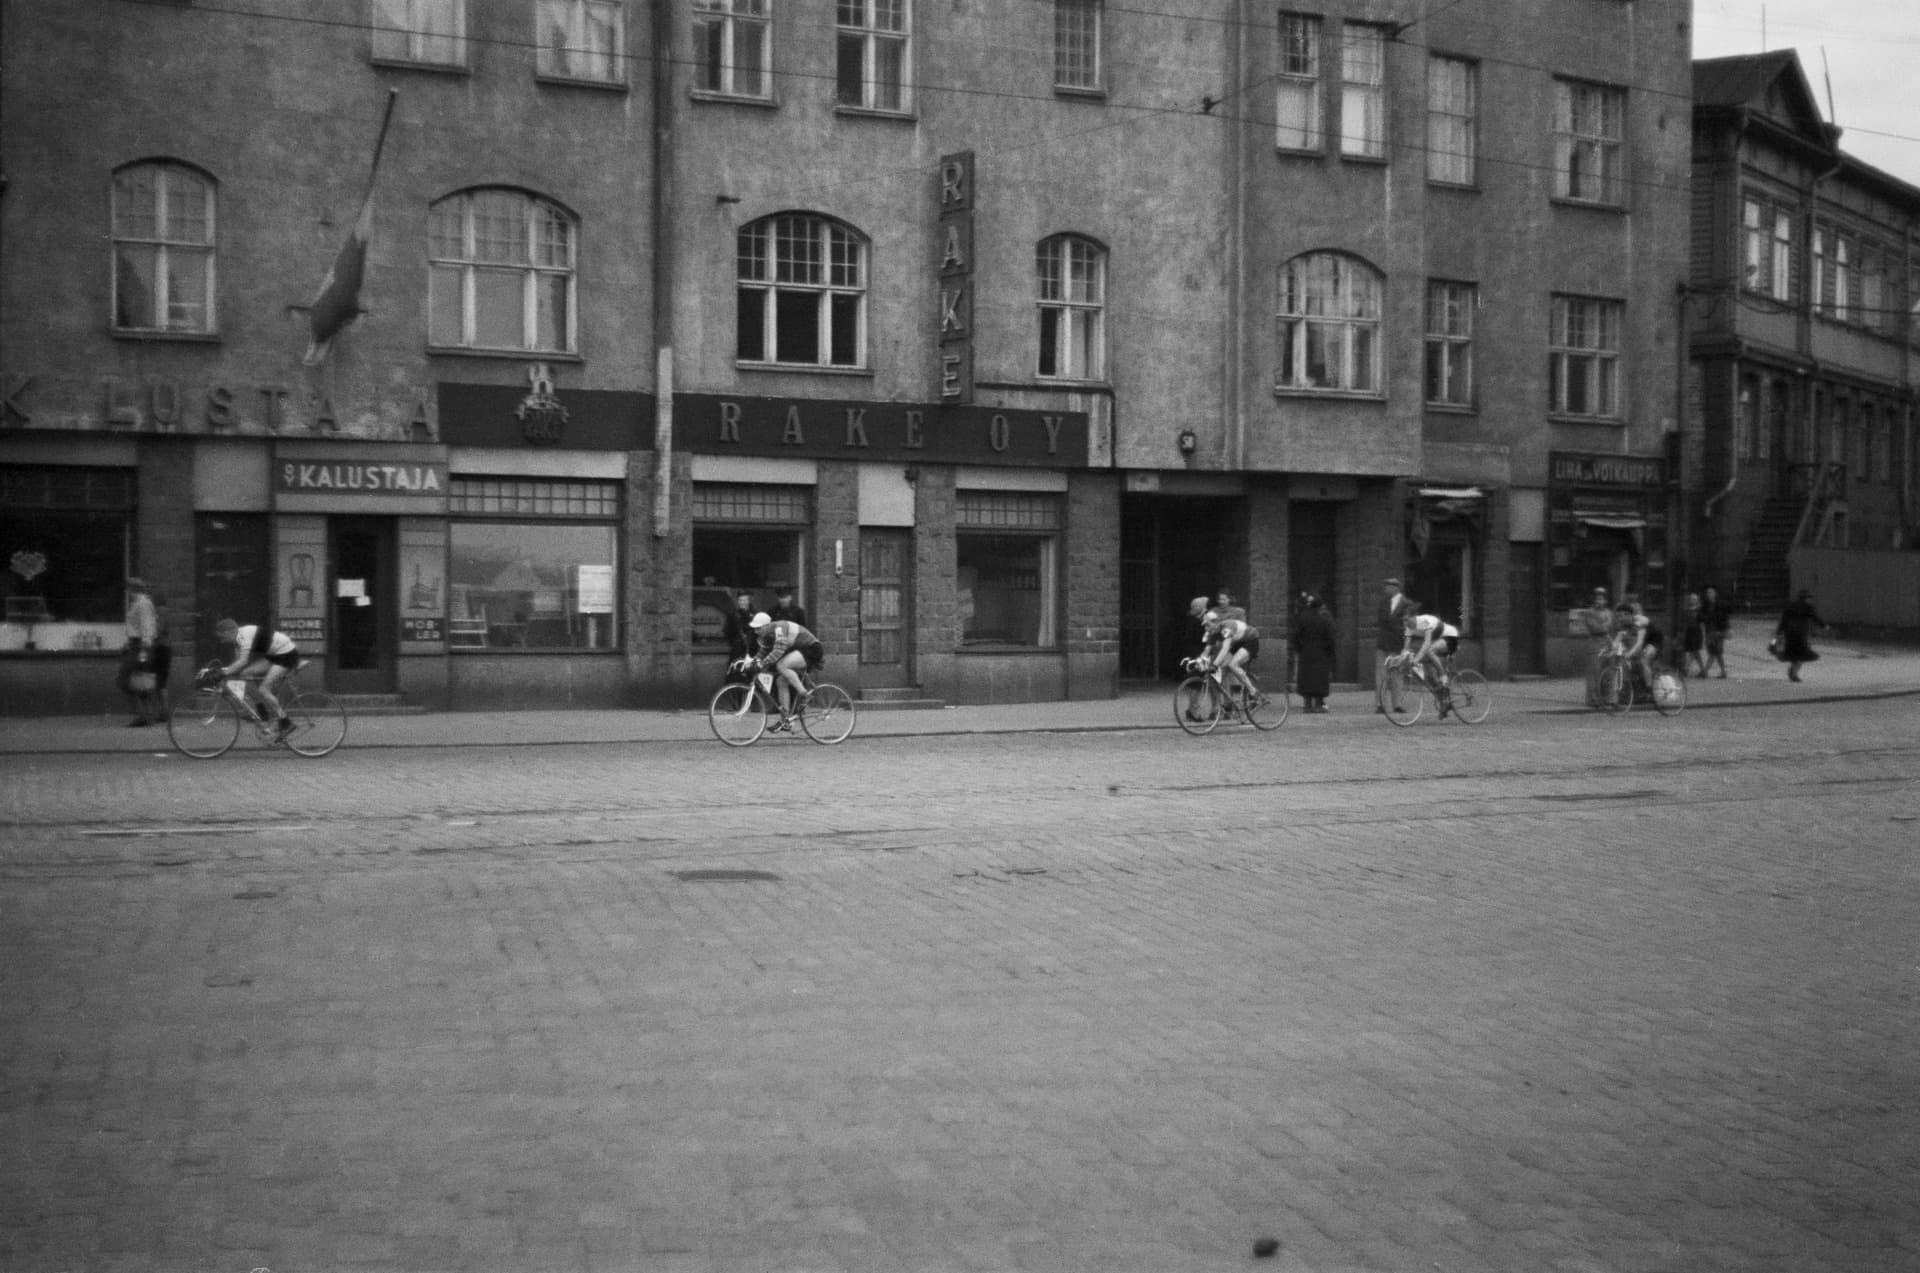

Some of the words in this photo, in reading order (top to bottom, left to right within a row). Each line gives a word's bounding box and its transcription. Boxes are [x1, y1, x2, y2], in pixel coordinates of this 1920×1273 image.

[941, 161, 964, 397] RAKE
[719, 402, 924, 449] RAKE
[990, 415, 1063, 453] OY
[300, 465, 440, 490] KALUSTAJA
